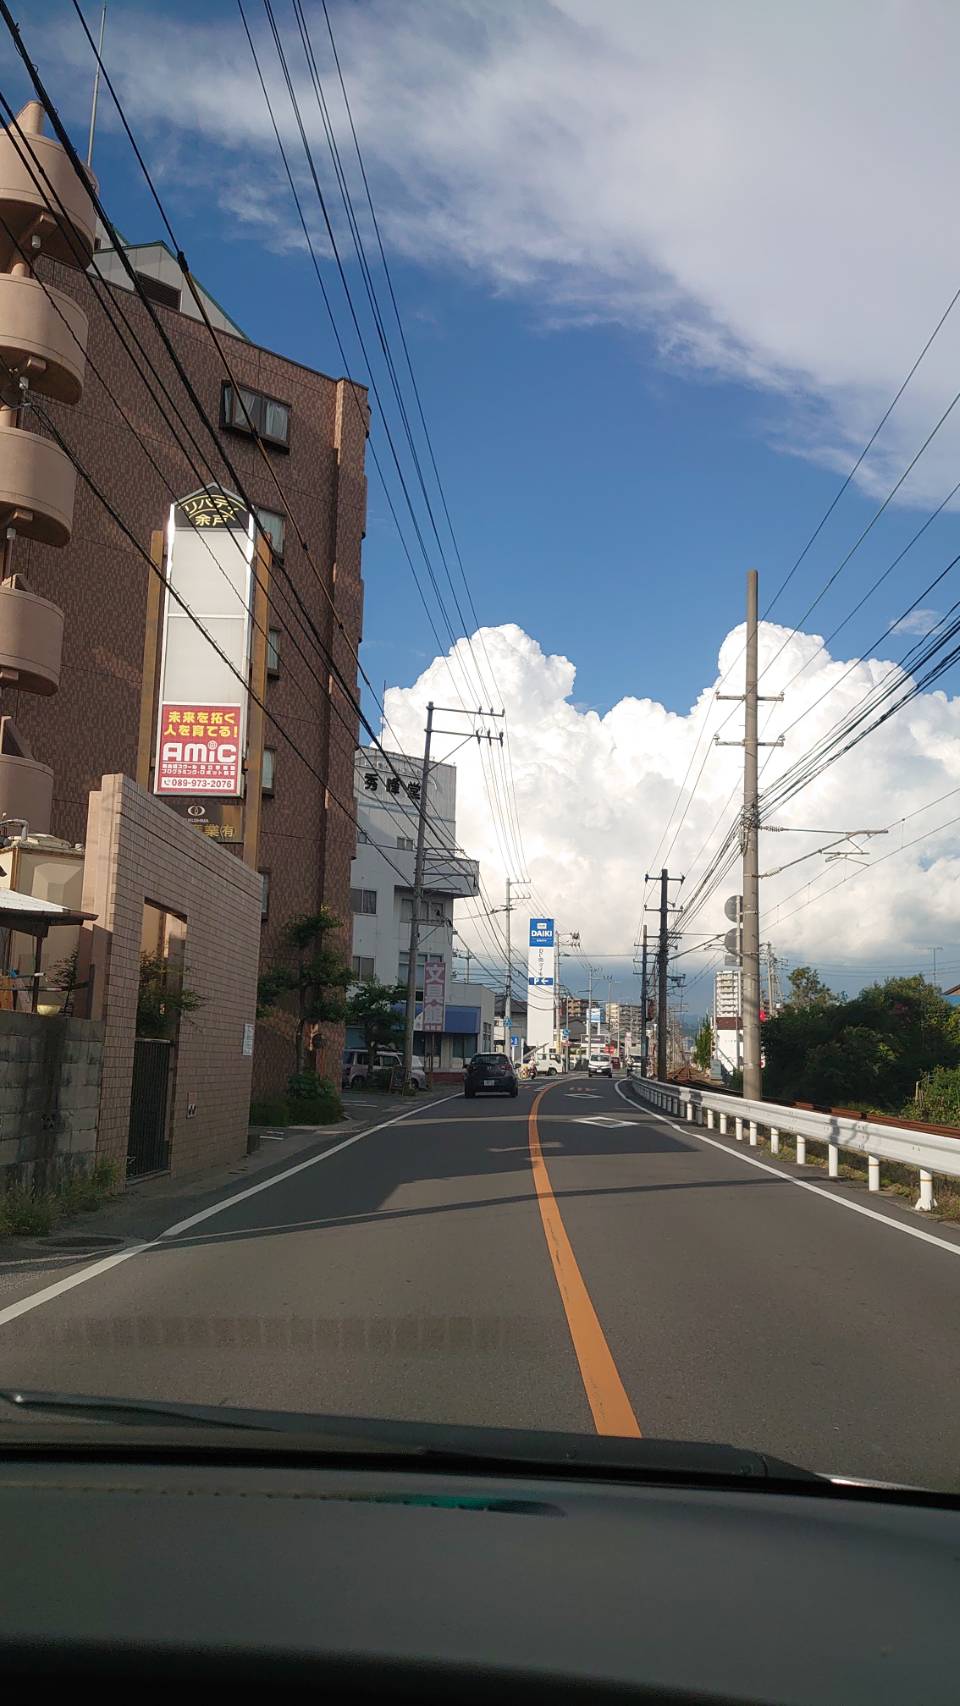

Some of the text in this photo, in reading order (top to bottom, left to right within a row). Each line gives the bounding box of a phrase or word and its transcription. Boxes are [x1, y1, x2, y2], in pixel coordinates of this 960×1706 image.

[184, 498, 239, 514] リバティ
[195, 514, 228, 526] 余戸
[168, 711, 235, 724] 未来を拓く
[171, 779, 232, 788] 089-973-2076
